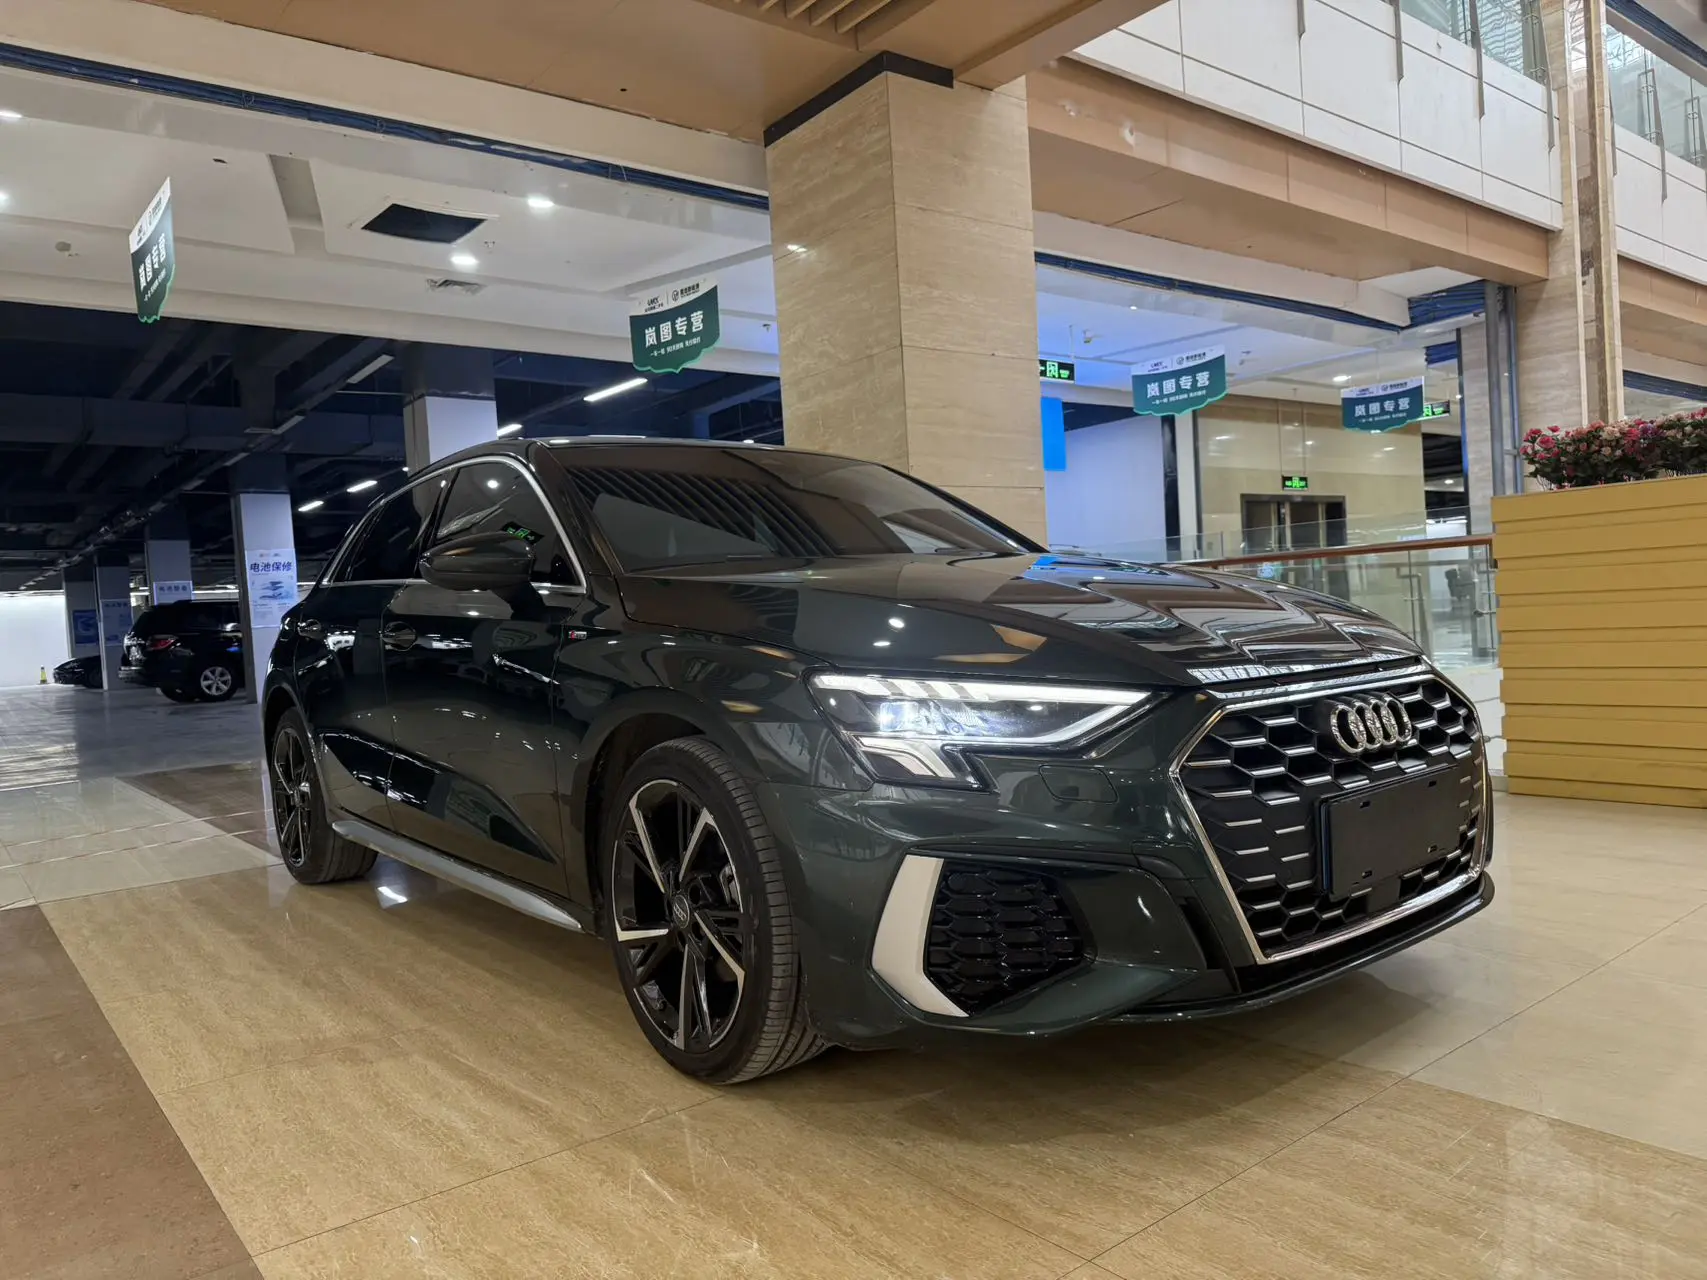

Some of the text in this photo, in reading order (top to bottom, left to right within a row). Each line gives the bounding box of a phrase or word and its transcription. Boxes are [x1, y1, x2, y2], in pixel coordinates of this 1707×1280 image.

[644, 310, 704, 348] 岚图专营
[250, 561, 292, 573] 电池保修
